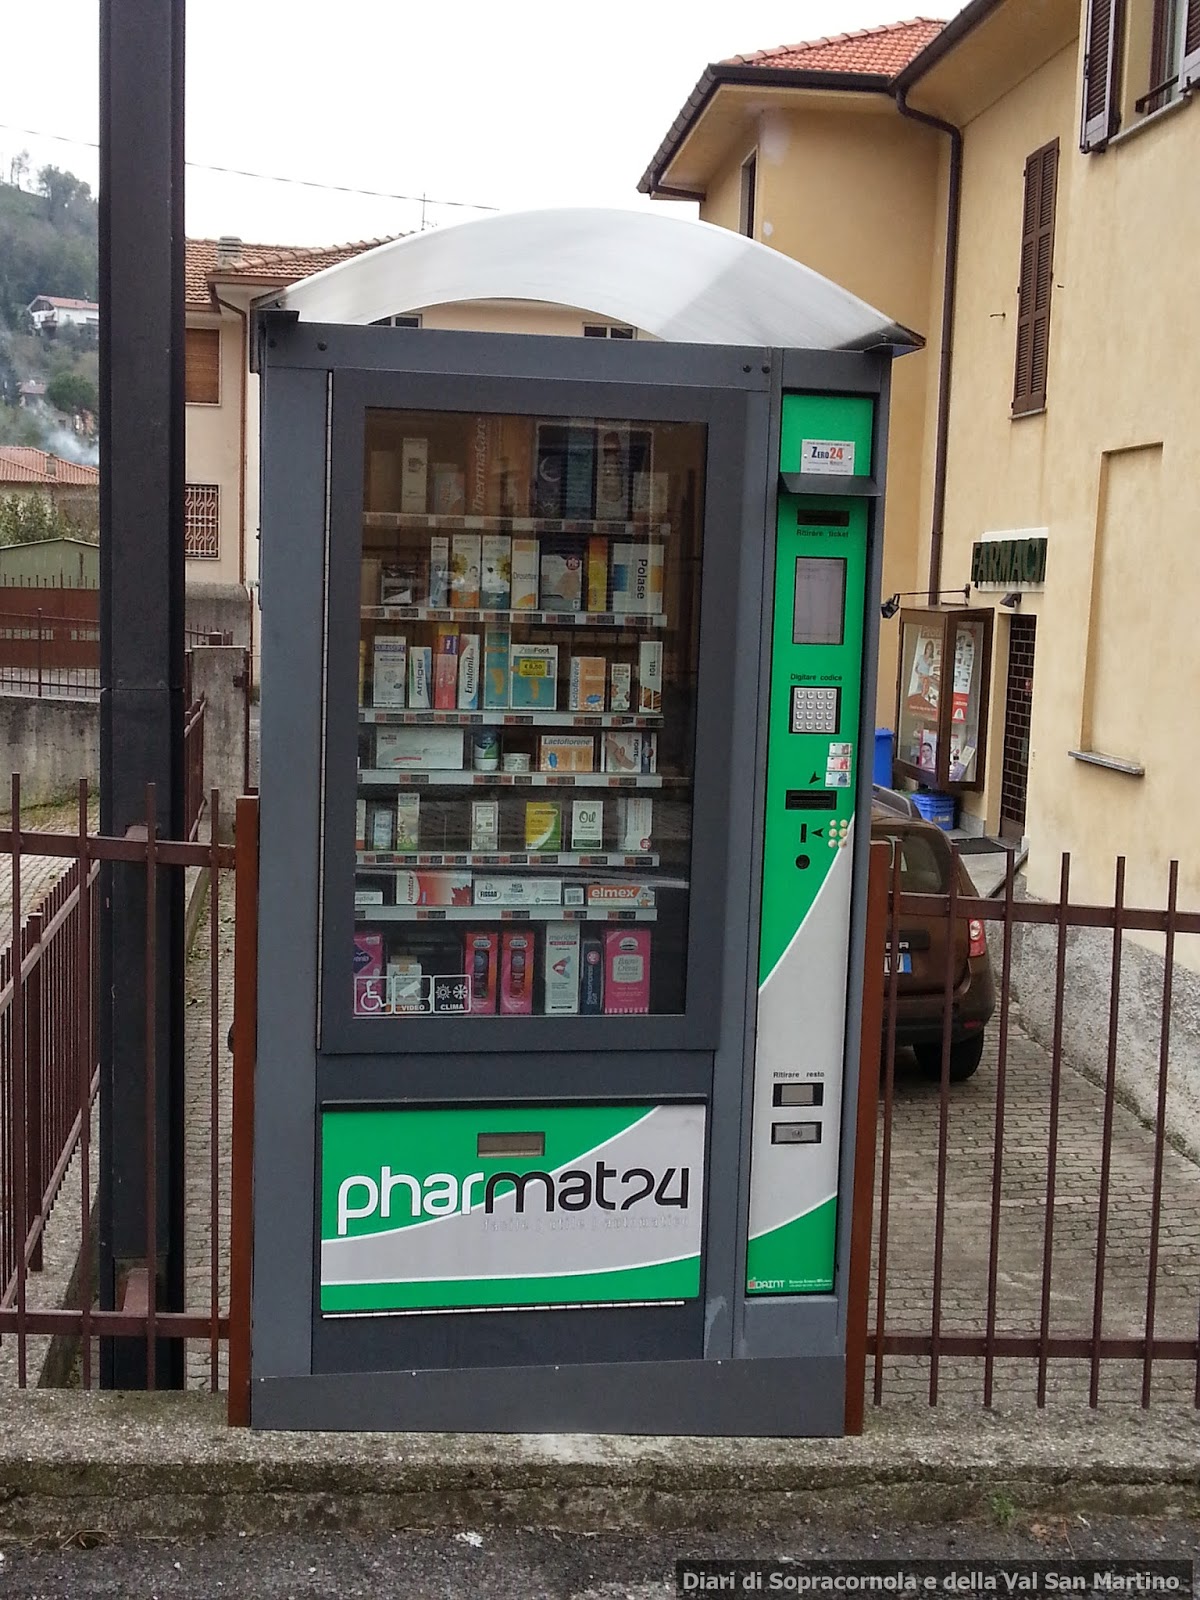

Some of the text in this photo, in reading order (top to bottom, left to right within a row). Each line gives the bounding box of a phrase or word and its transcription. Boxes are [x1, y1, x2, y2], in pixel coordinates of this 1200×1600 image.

[796, 528, 849, 537] Ritirare ticket
[636, 558, 648, 600] Polase
[416, 659, 424, 697] Arnigel
[465, 656, 474, 694] Ematonil
[790, 674, 817, 682] Digitare
[543, 737, 591, 745] Lactoflorene
[578, 810, 596, 824] Oil
[591, 887, 636, 898] elmex
[440, 1003, 464, 1011] CLIMA
[773, 1071, 800, 1079] Ritirare
[337, 1160, 691, 1236] pharmat24
